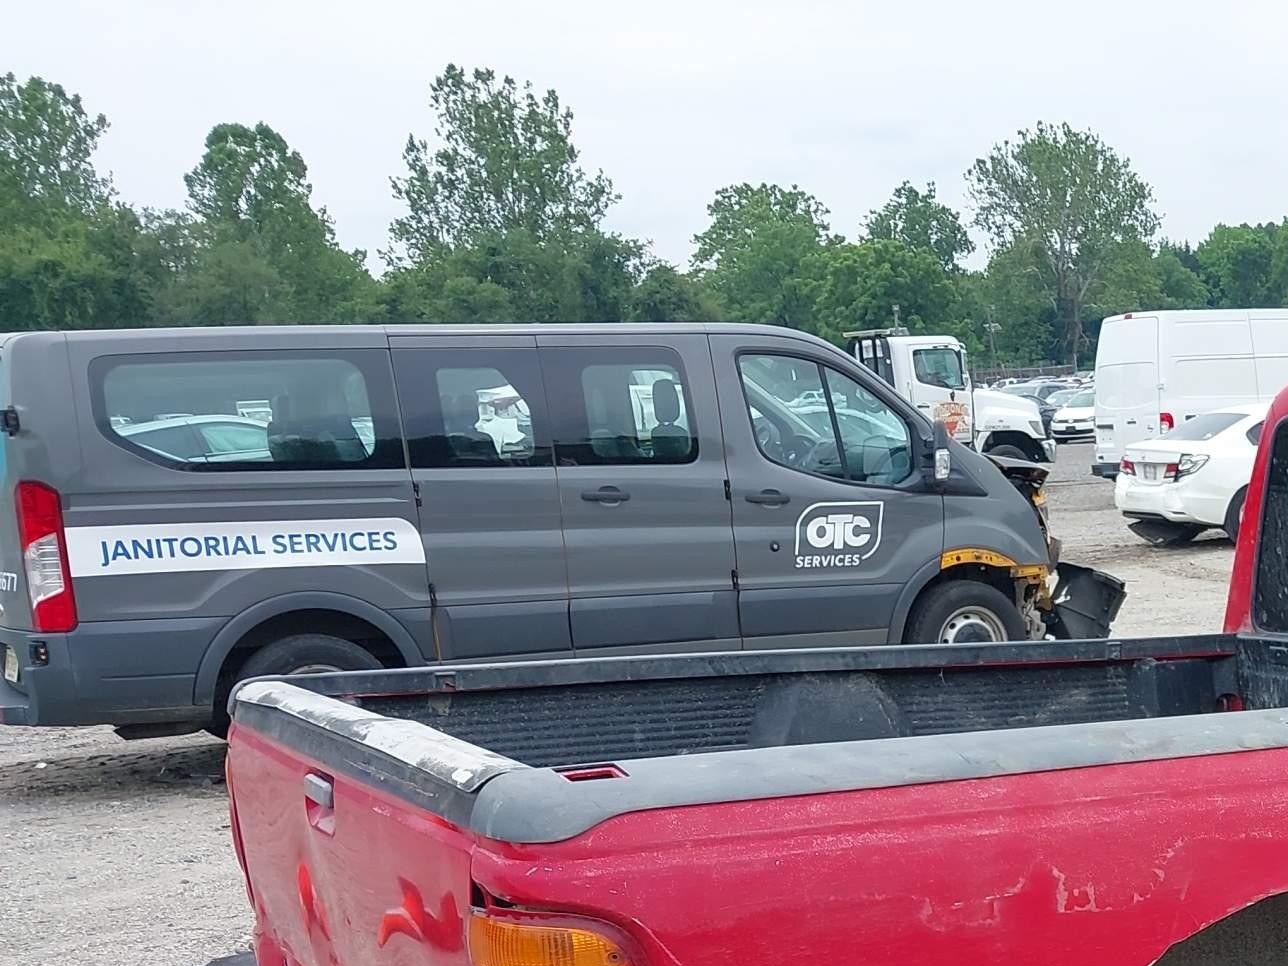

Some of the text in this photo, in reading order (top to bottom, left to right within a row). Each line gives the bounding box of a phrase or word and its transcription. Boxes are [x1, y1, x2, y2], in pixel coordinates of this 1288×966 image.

[806, 514, 871, 550] OTC
[101, 531, 398, 567] JANITORIAL SERVICES
[795, 554, 860, 568] SERVICES
[0, 571, 17, 592] 677
